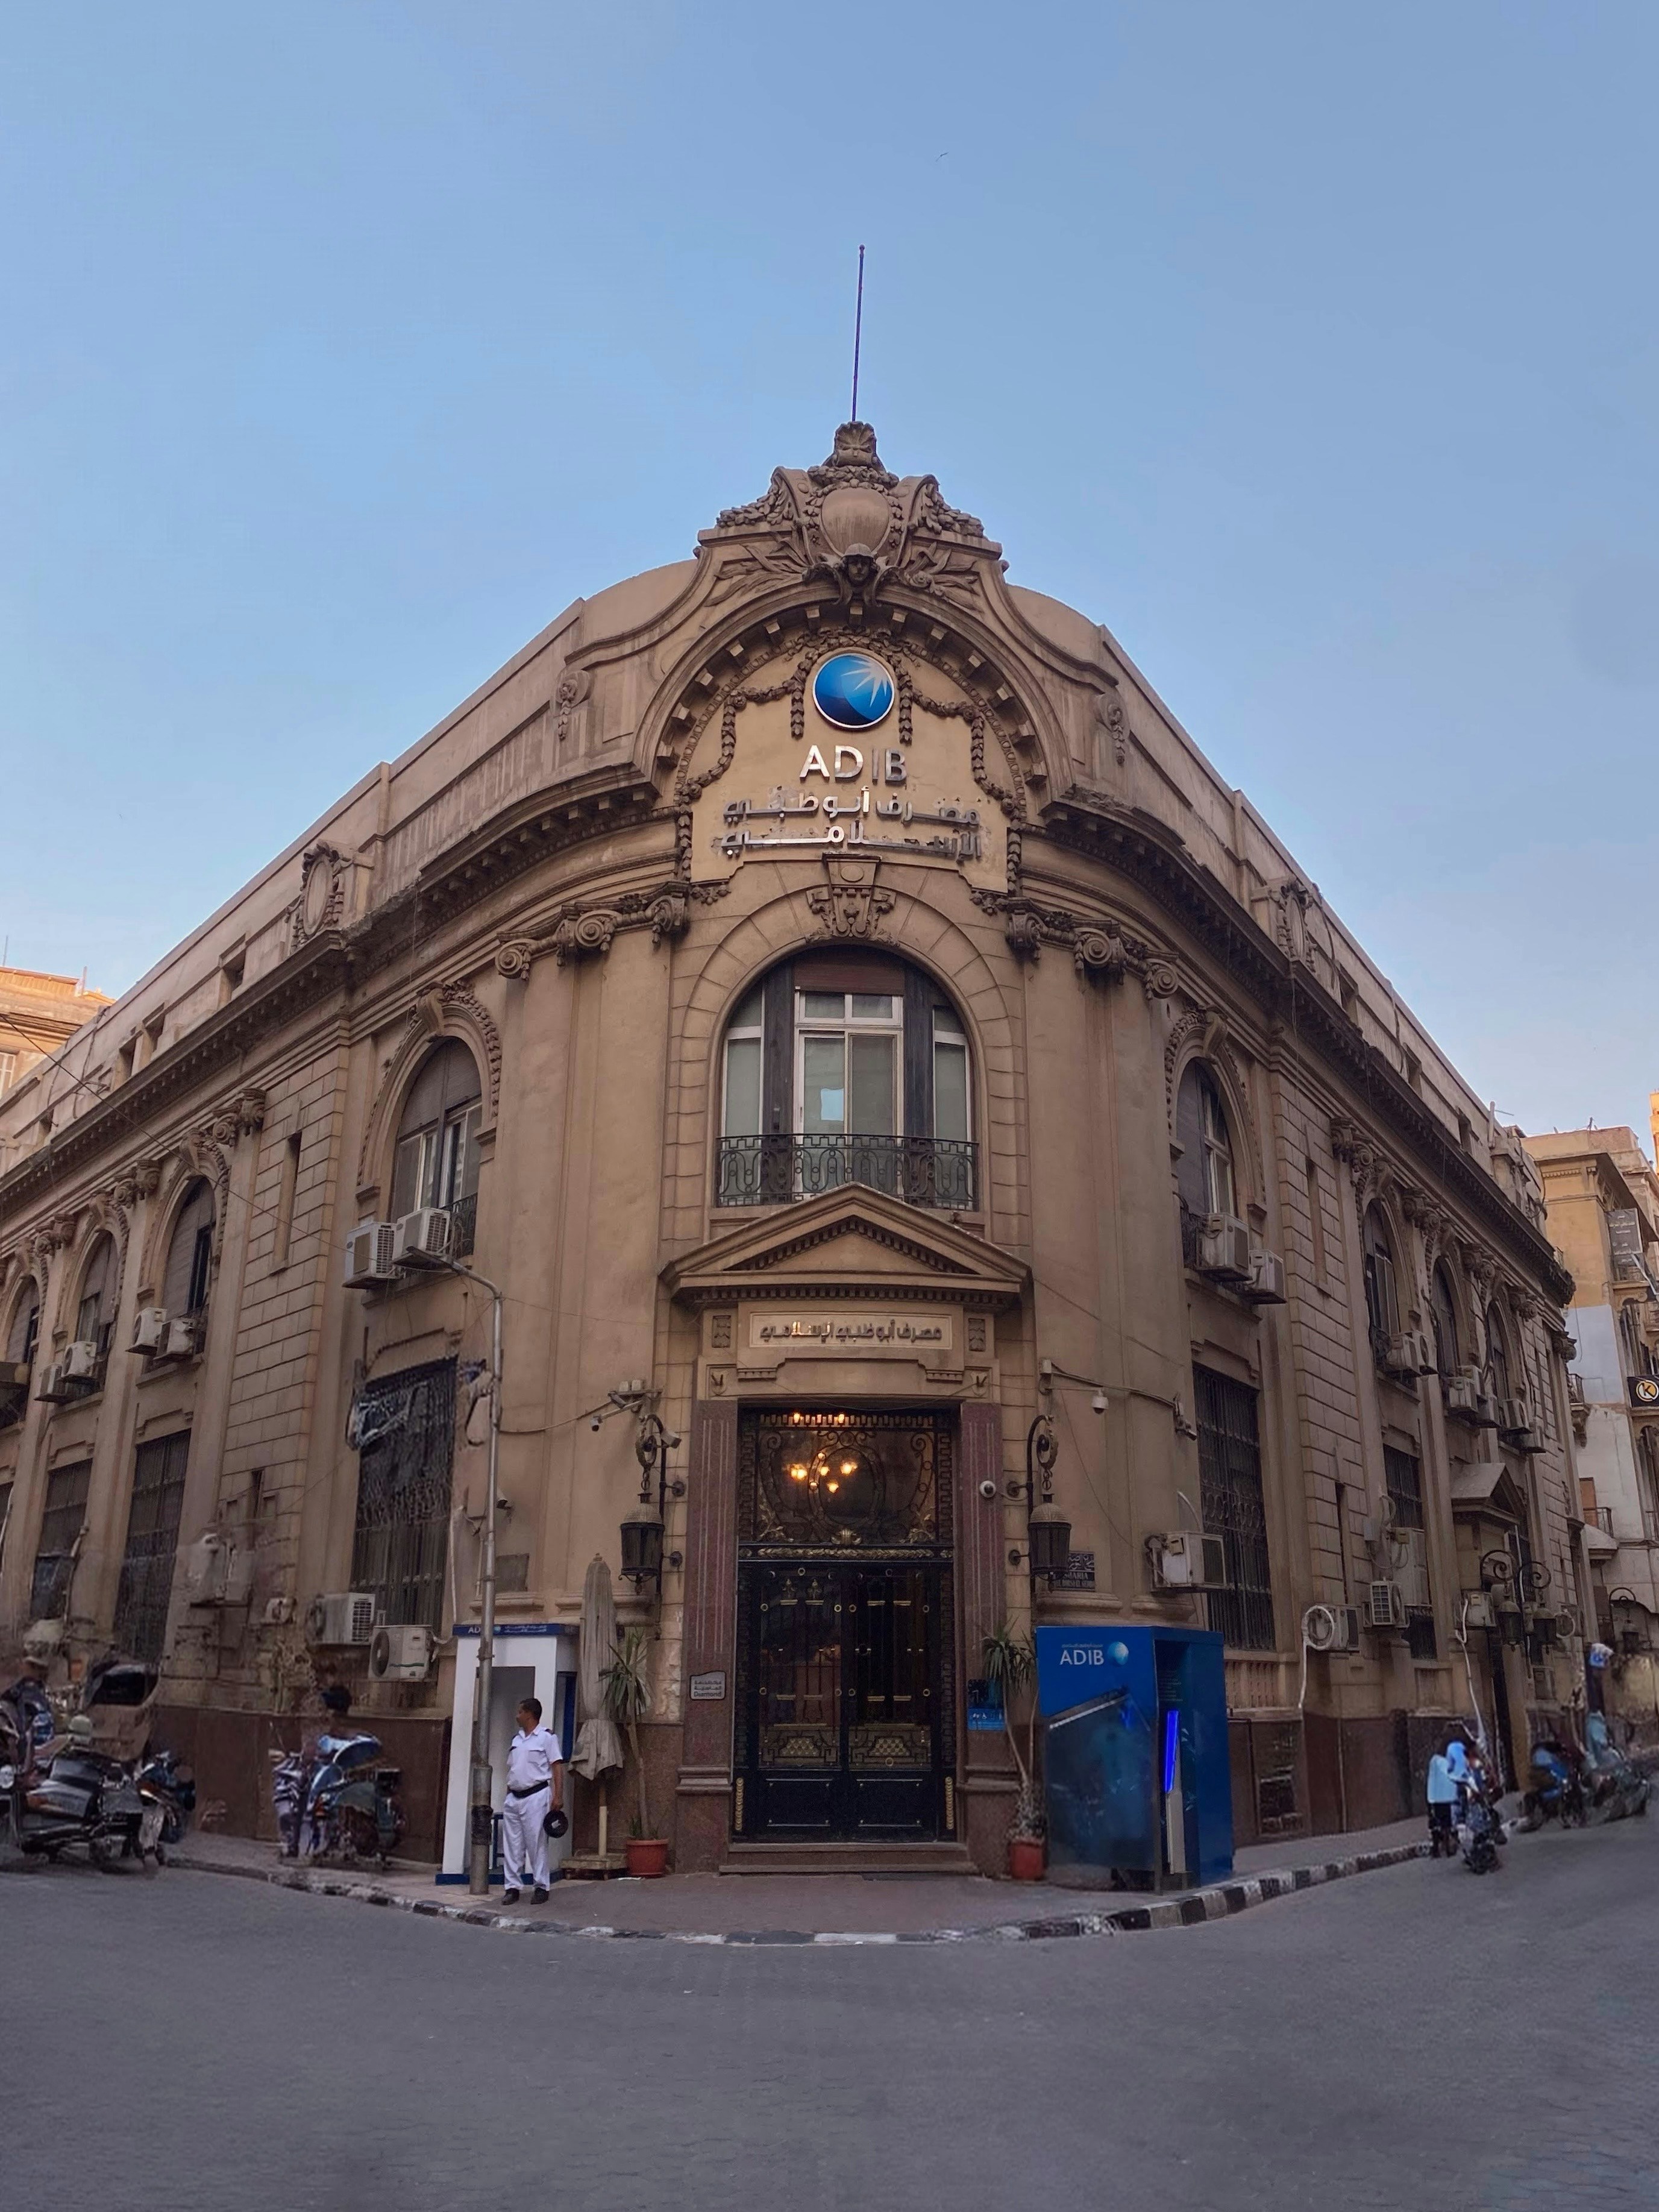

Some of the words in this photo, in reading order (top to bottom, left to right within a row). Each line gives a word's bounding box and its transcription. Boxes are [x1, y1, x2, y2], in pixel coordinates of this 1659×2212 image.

[800, 745, 906, 784] ADIB
[876, 793, 980, 828] مصرف
[897, 1322, 942, 1343] مصرف
[1060, 1649, 1105, 1665] ADIB
